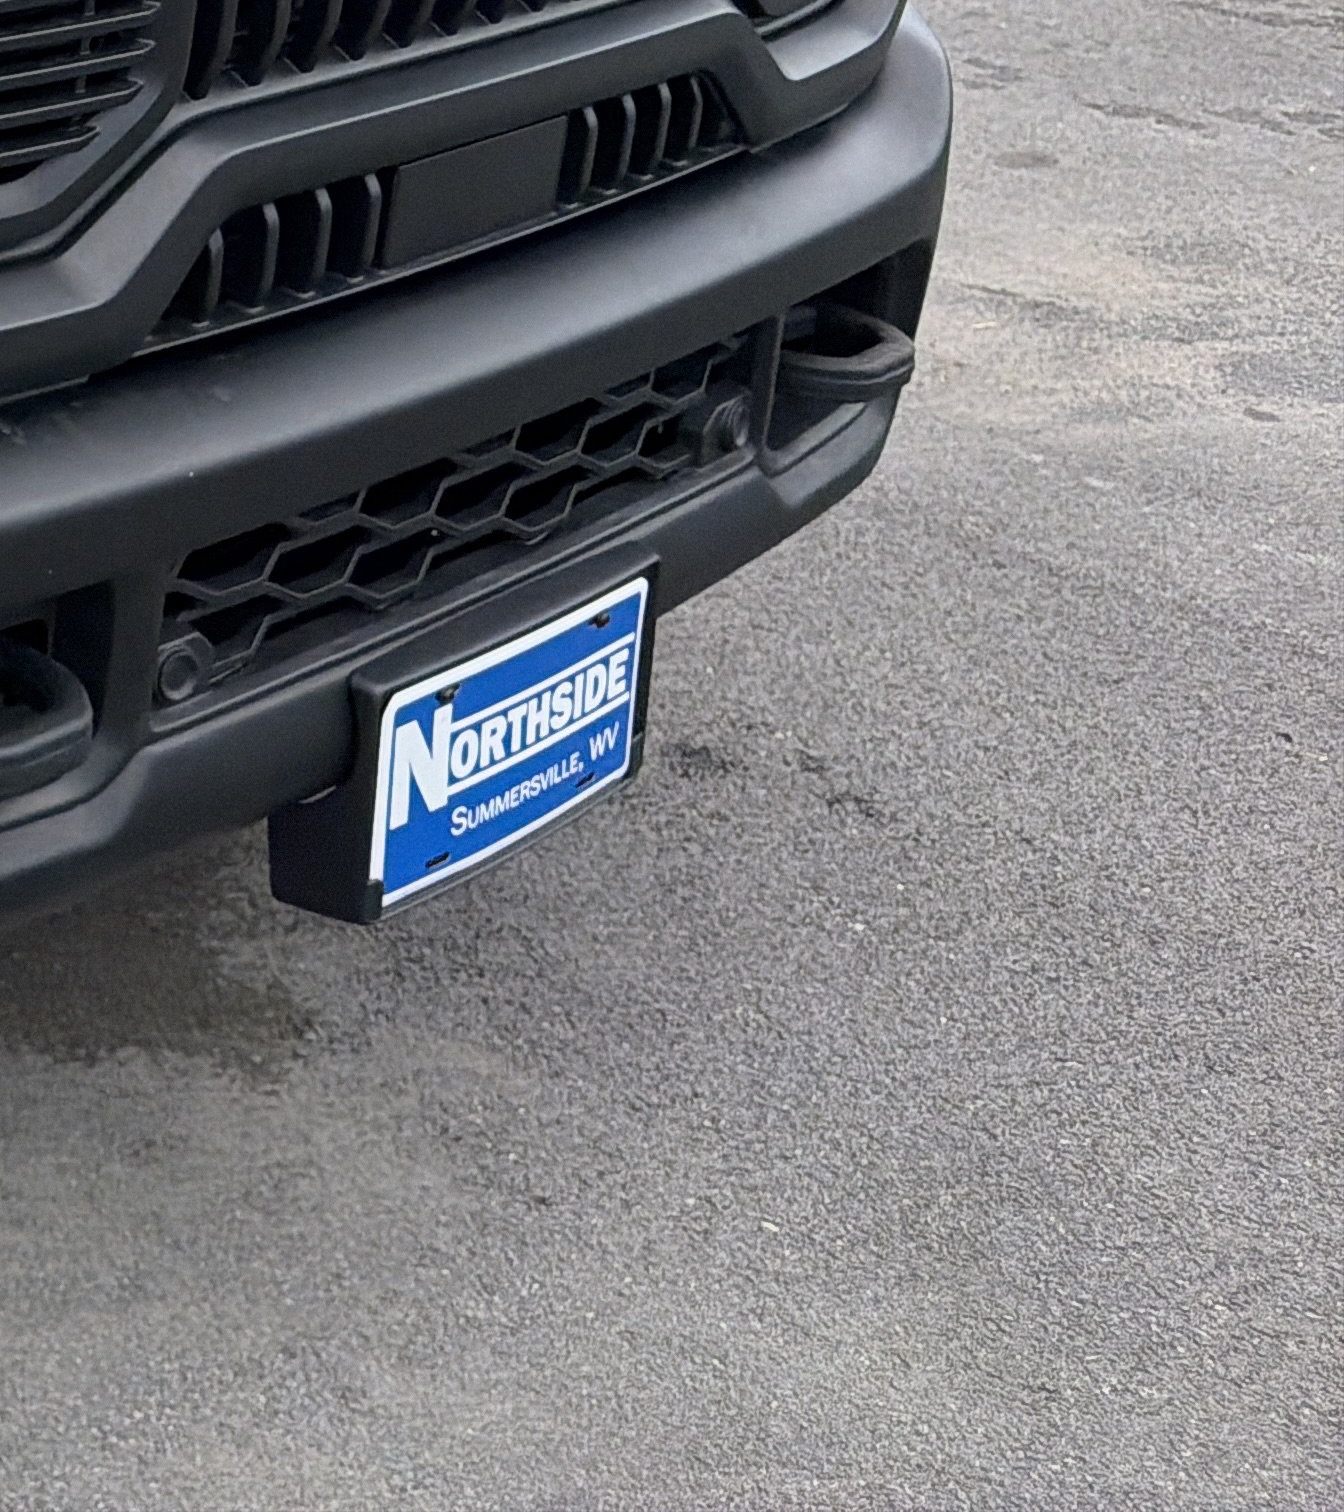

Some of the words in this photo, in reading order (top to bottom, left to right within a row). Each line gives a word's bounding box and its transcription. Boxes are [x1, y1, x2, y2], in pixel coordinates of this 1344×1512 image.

[389, 646, 631, 831] NORTHSIDE
[450, 749, 585, 837] SUMMERSVILLE,
[588, 721, 620, 761] WV
